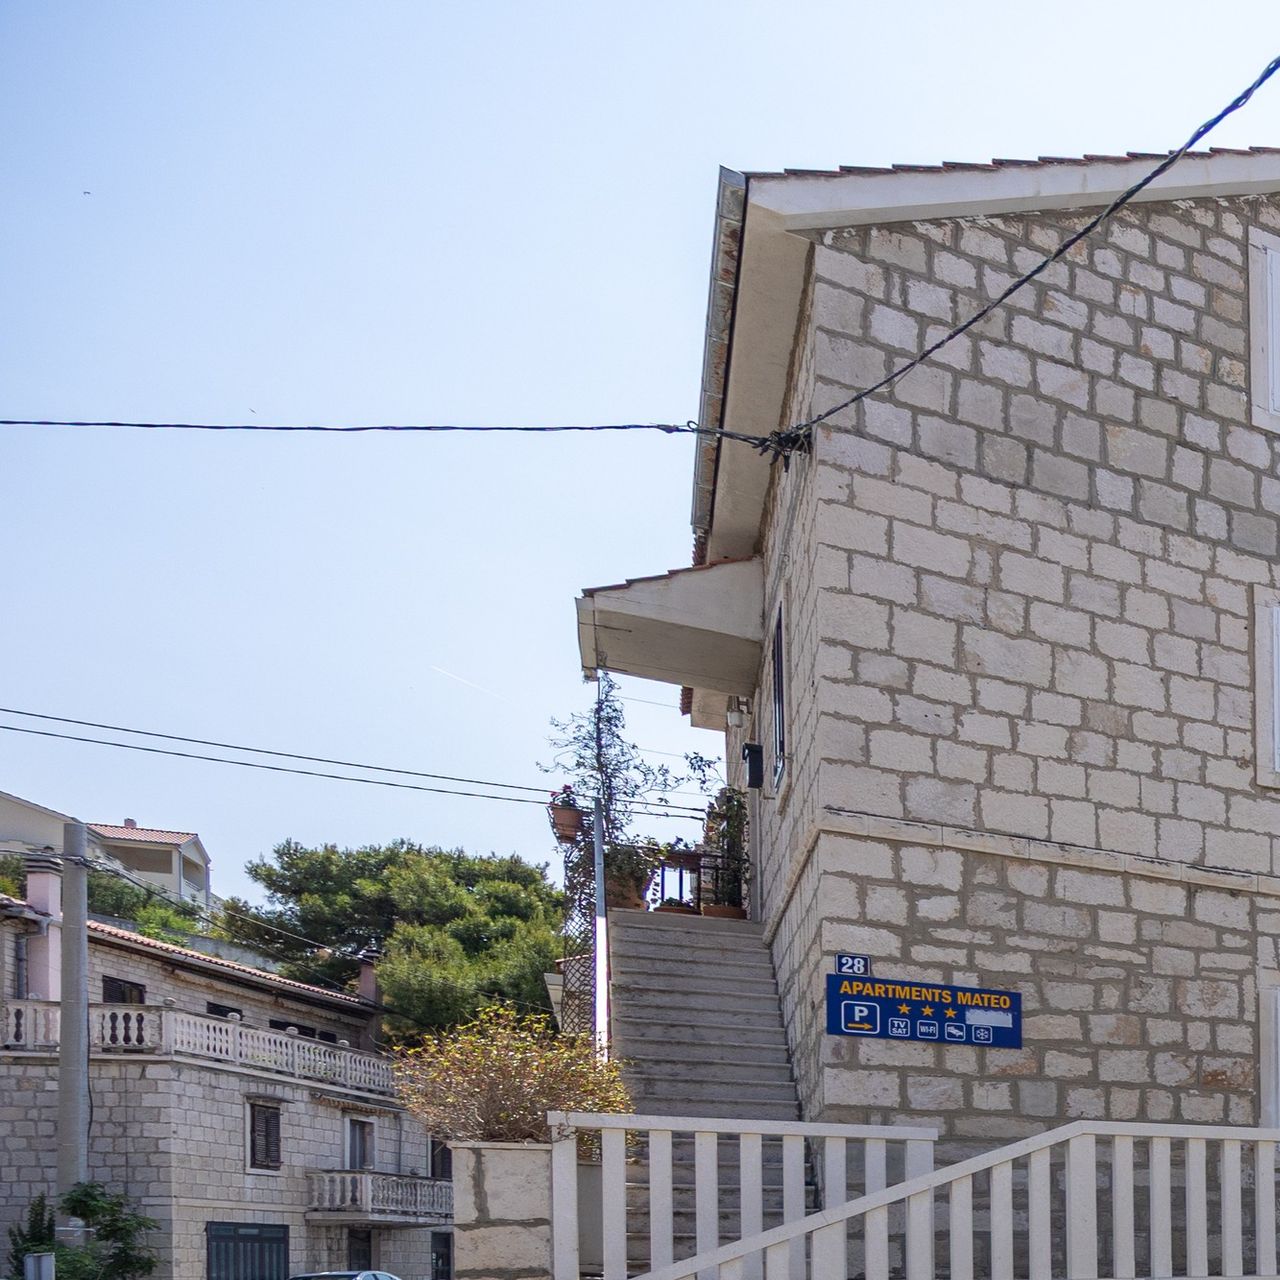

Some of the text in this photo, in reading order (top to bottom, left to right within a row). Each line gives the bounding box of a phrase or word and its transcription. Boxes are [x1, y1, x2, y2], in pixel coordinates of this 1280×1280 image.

[841, 956, 865, 974] 28
[840, 980, 1011, 1009] APARTMENTS MATEO
[854, 1006, 869, 1022] P
[891, 1027, 907, 1035] SAT
[892, 1020, 907, 1028] TV
